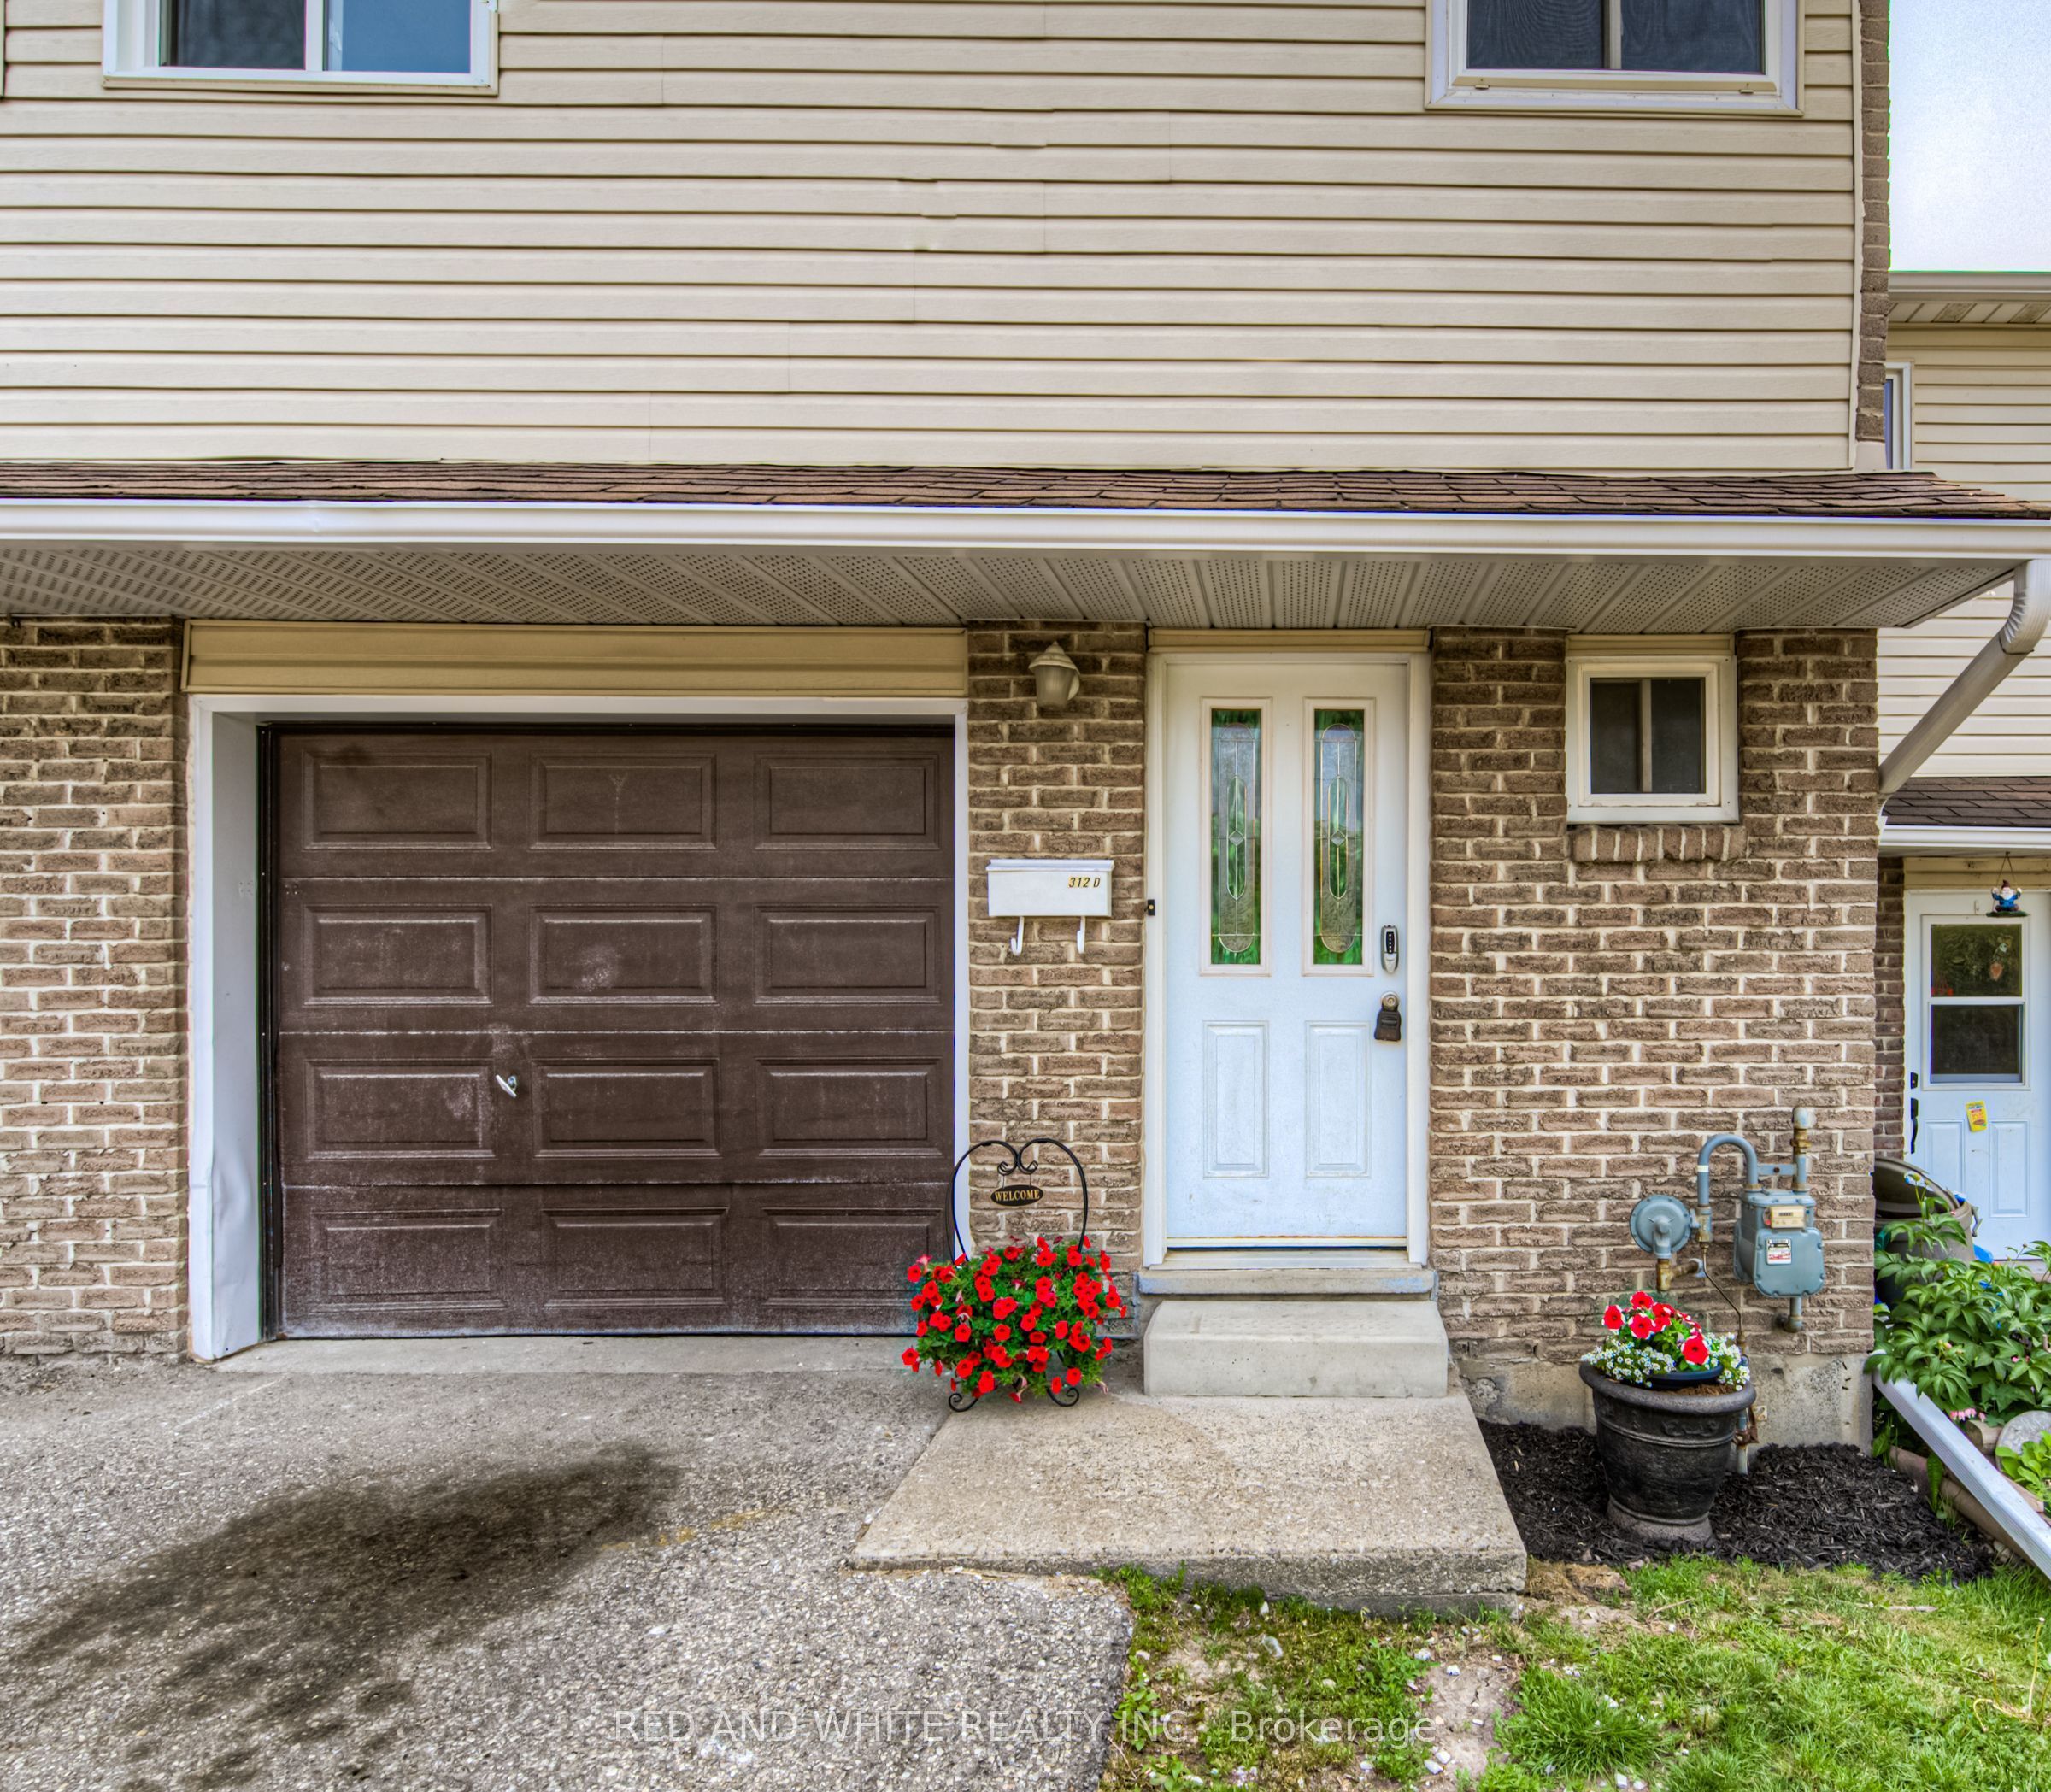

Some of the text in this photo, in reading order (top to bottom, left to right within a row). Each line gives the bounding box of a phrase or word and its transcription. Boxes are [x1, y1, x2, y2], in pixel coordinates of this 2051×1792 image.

[1068, 877, 1101, 888] 312 D
[994, 1189, 1040, 1202] WELCOME
